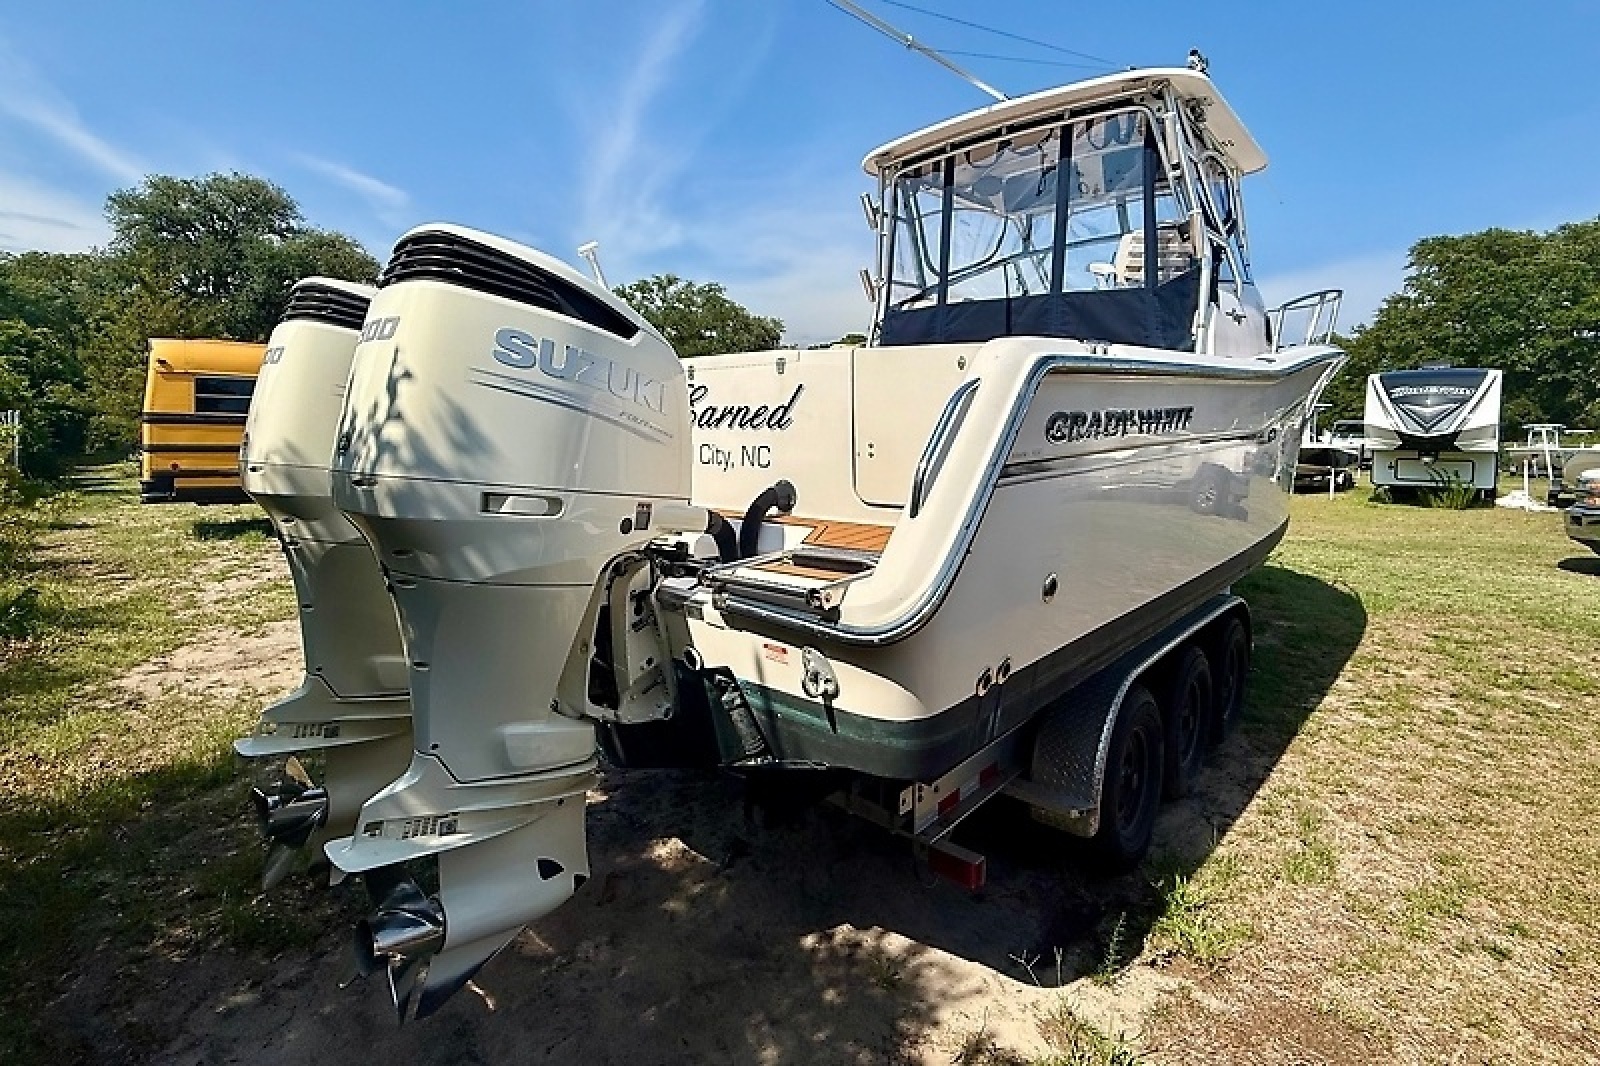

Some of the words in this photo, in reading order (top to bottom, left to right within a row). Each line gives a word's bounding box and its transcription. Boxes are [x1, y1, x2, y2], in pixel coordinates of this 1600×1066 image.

[362, 316, 400, 342] 00
[493, 327, 667, 416] SUZUKI
[699, 443, 735, 472] City,
[741, 445, 771, 468] NC
